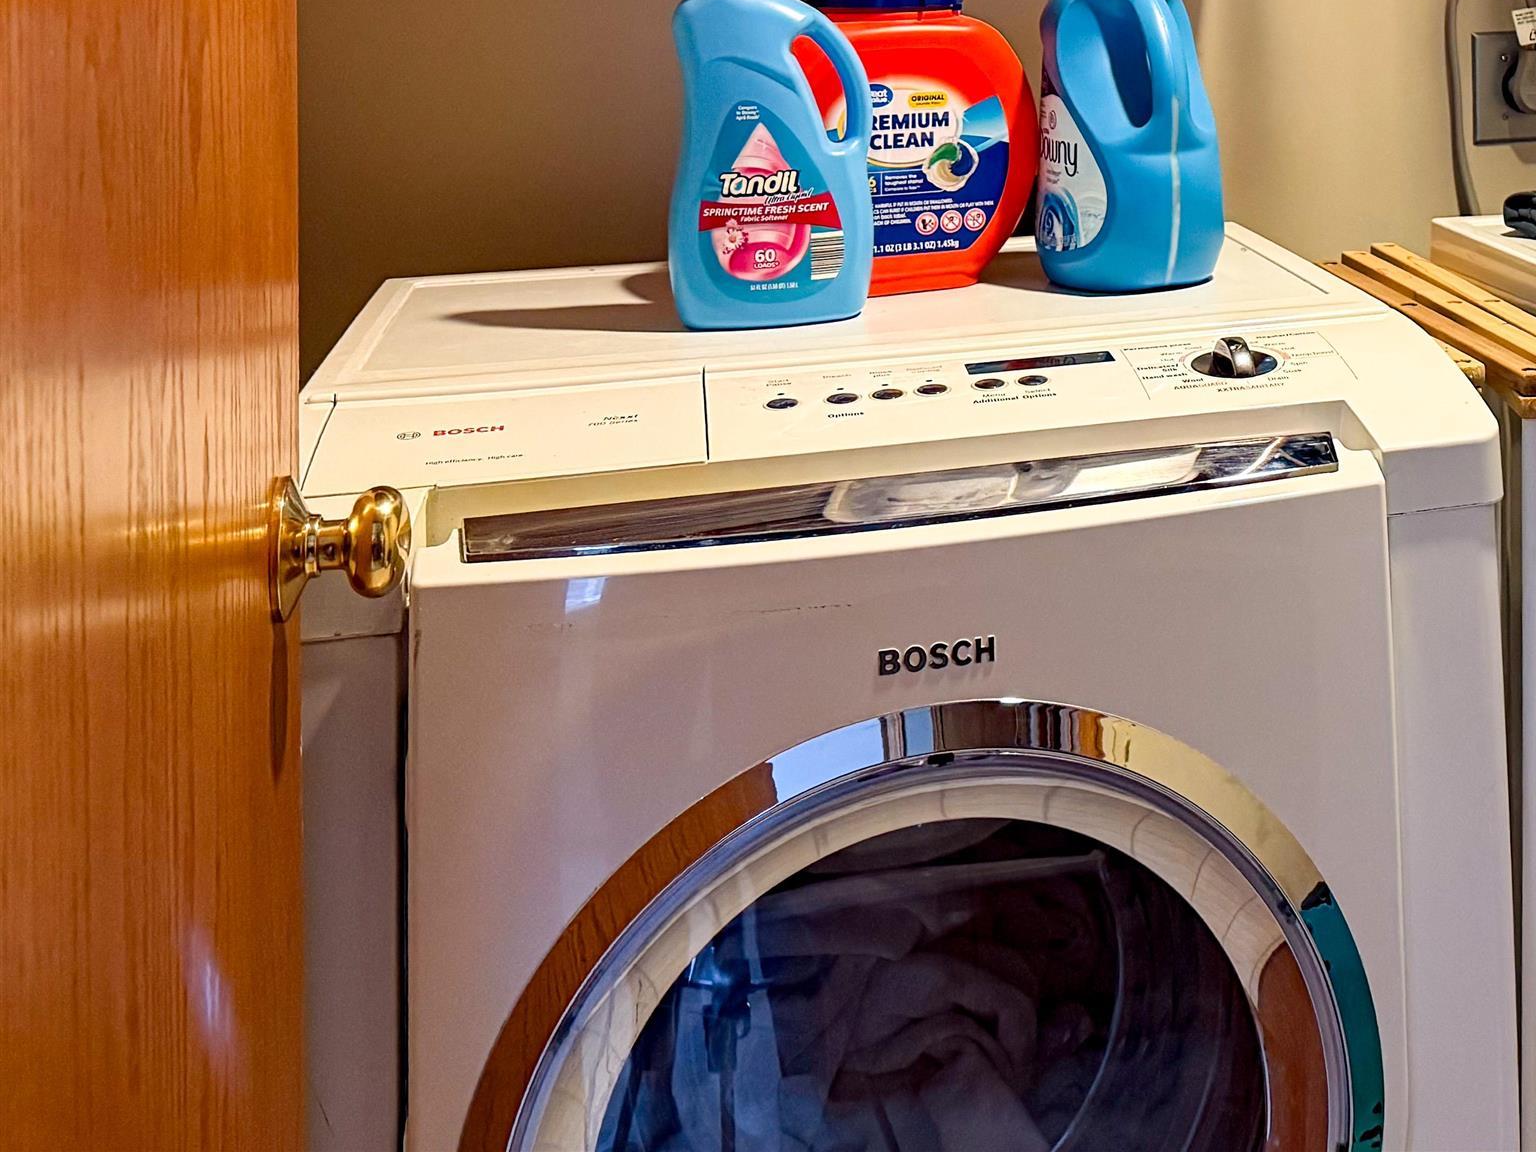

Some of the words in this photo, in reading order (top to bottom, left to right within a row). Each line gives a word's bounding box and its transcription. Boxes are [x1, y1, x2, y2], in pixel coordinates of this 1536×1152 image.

[911, 94, 945, 102] ORIGINAL
[872, 111, 949, 131] REMIUM
[870, 131, 934, 150] CLEAN
[720, 169, 799, 196] Tandil
[703, 206, 763, 217] SPRINGTIME
[764, 204, 796, 216] FRESH
[797, 202, 829, 213] SCENT
[740, 215, 760, 223] Fabric
[761, 214, 788, 222] Softener
[754, 248, 776, 263] 60
[973, 396, 1019, 404] Additional
[433, 425, 505, 436] BOSCH
[878, 635, 996, 676] BOSCH
